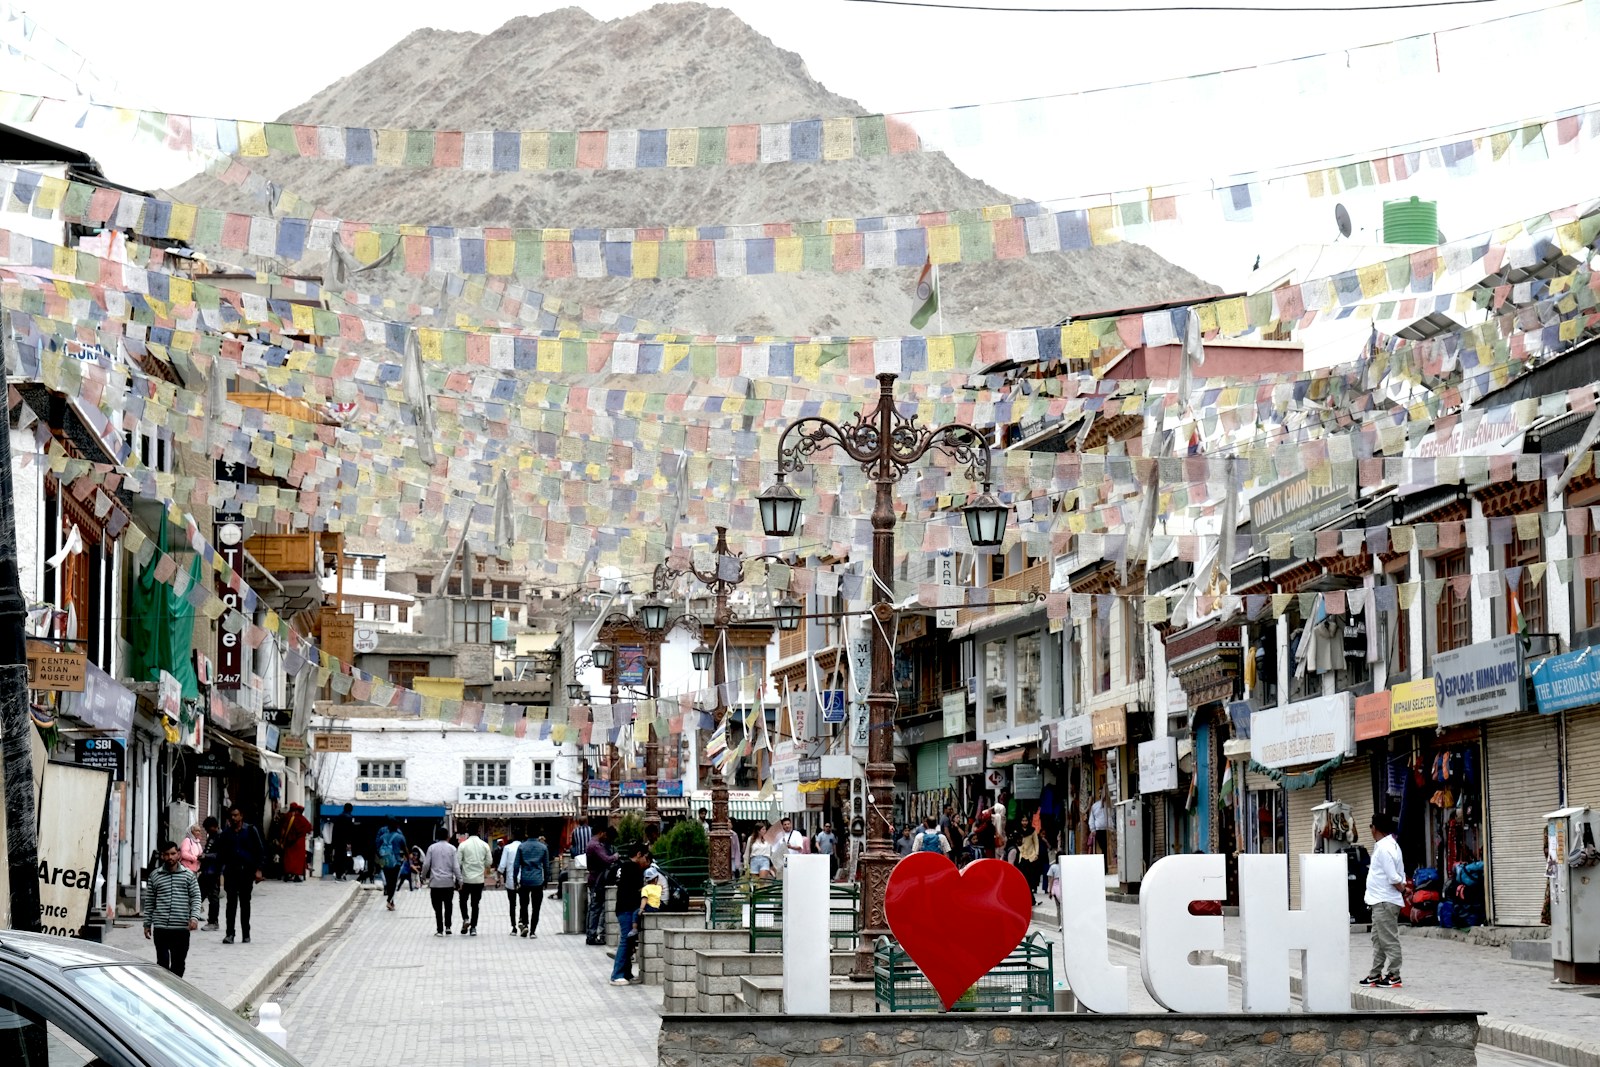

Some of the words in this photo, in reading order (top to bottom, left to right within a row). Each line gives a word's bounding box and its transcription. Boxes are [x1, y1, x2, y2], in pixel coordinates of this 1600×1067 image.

[1284, 479, 1313, 513] GOODS
[857, 644, 868, 668] MY
[41, 674, 79, 682] MUSEUM
[217, 674, 240, 683] 24x7
[1445, 671, 1475, 698] EXPLORE
[1475, 661, 1517, 691] HIMALAYAS
[1535, 682, 1552, 701] THE
[1552, 673, 1591, 698] MERIDIAN
[1412, 696, 1435, 711] SELECTED
[95, 740, 112, 750] SBI
[515, 792, 563, 800] Gift
[1060, 853, 1352, 1014] LEH
